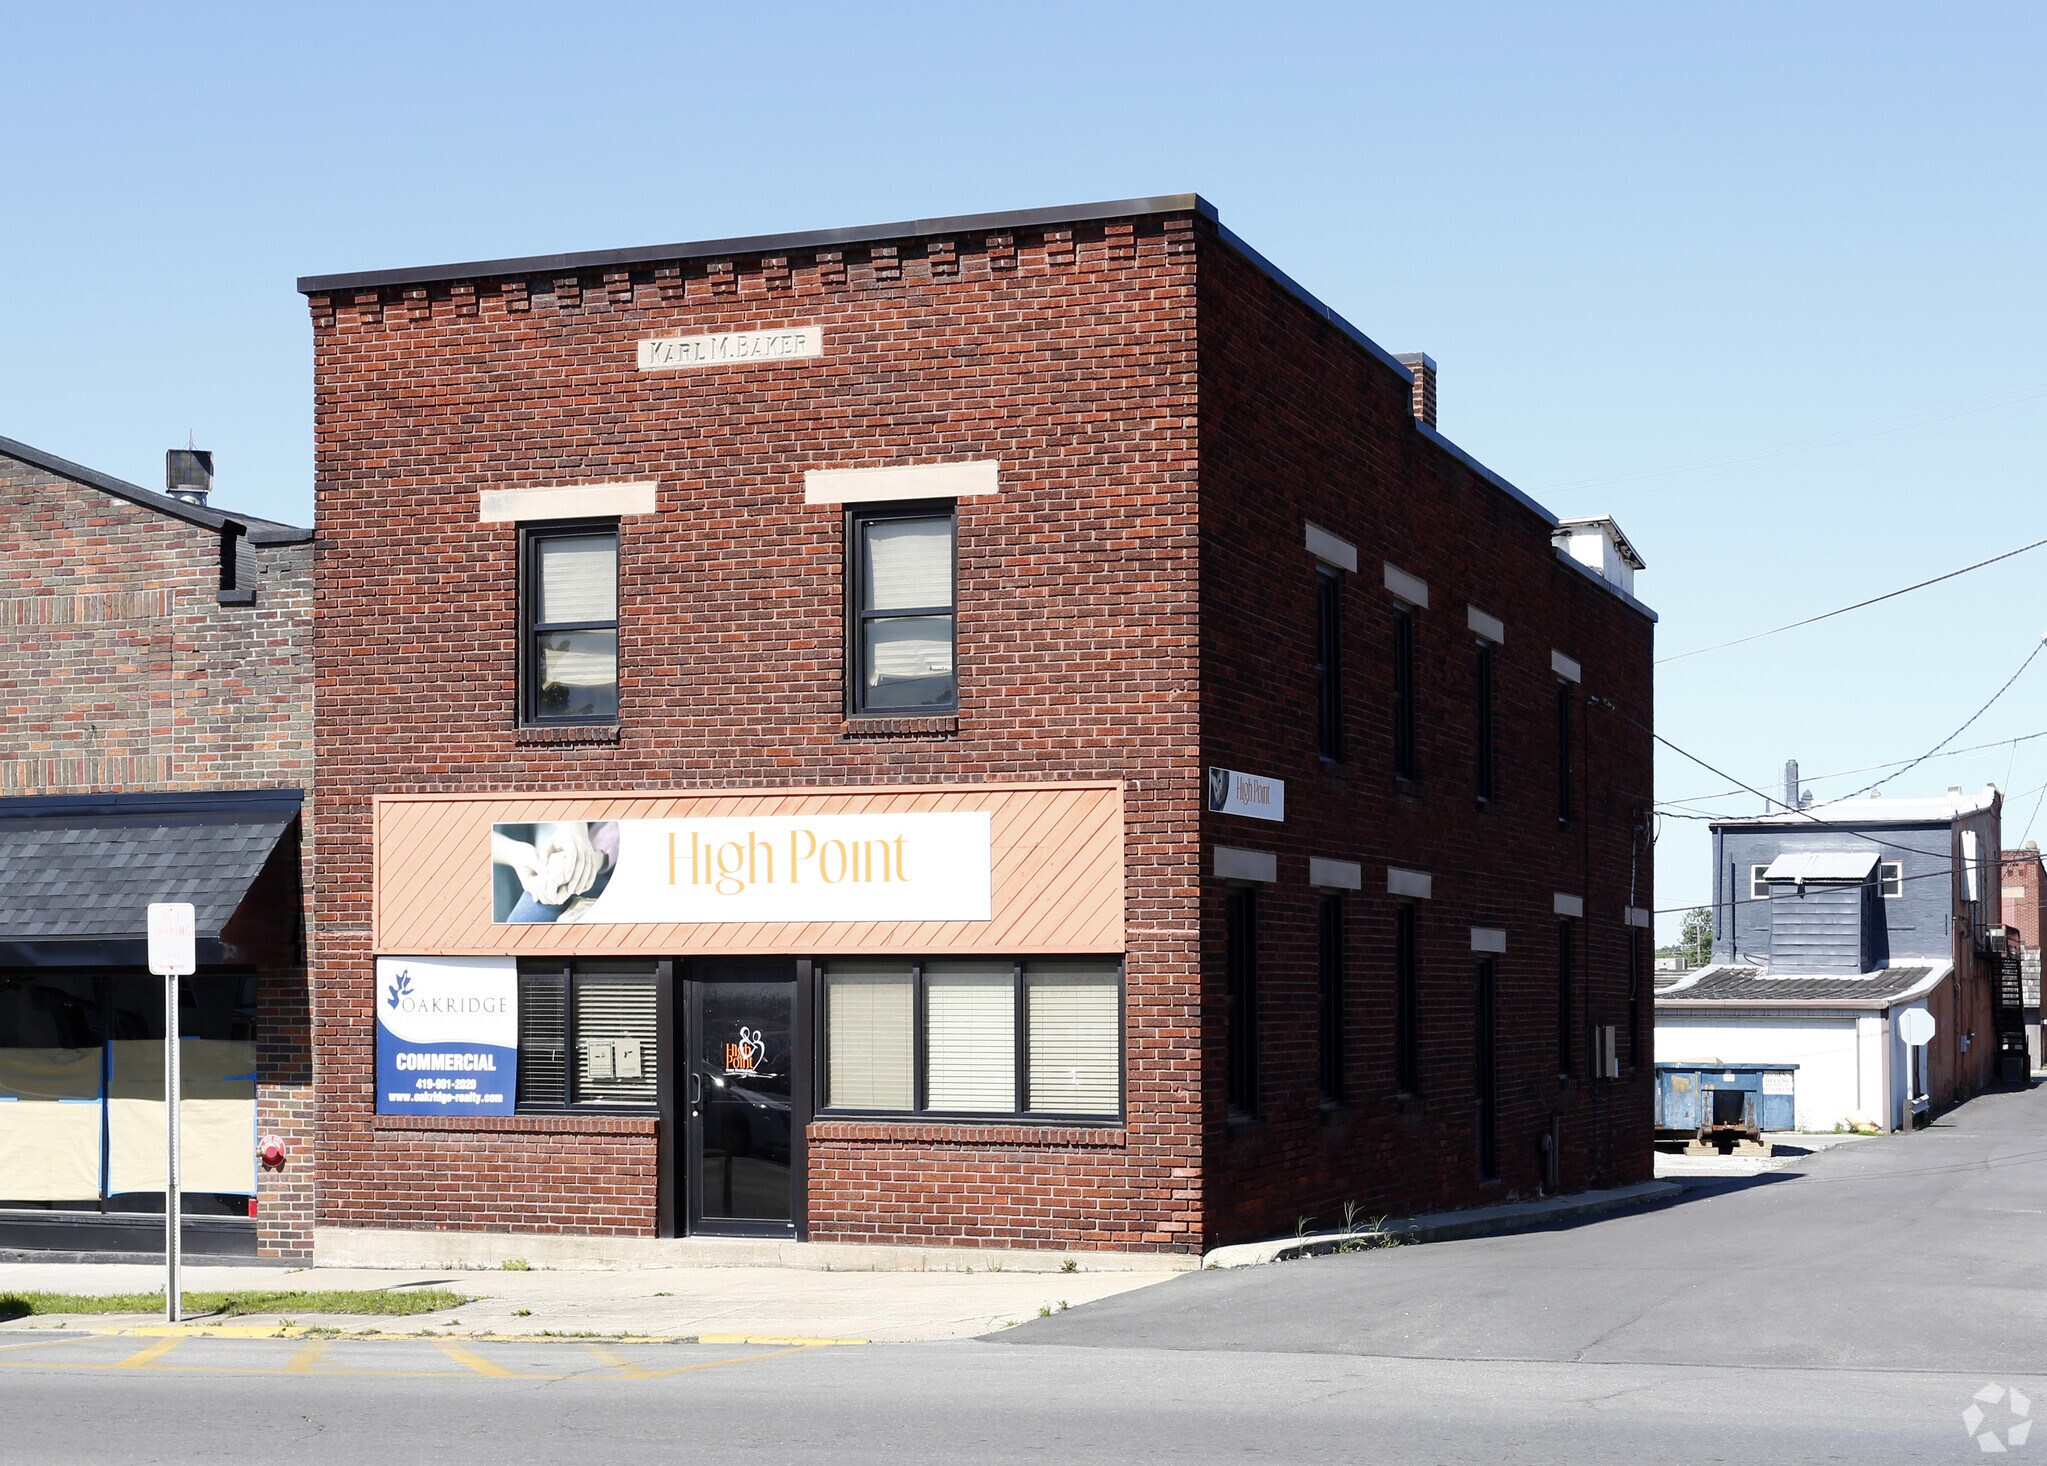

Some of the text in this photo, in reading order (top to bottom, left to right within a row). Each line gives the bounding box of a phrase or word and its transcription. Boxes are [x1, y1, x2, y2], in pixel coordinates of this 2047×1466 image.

[649, 341, 706, 364] KARL
[1236, 776, 1271, 806] High Point
[667, 829, 913, 896] High Point
[402, 997, 507, 1013] OAKRIDGE
[396, 1053, 497, 1072] COMMERCIAL
